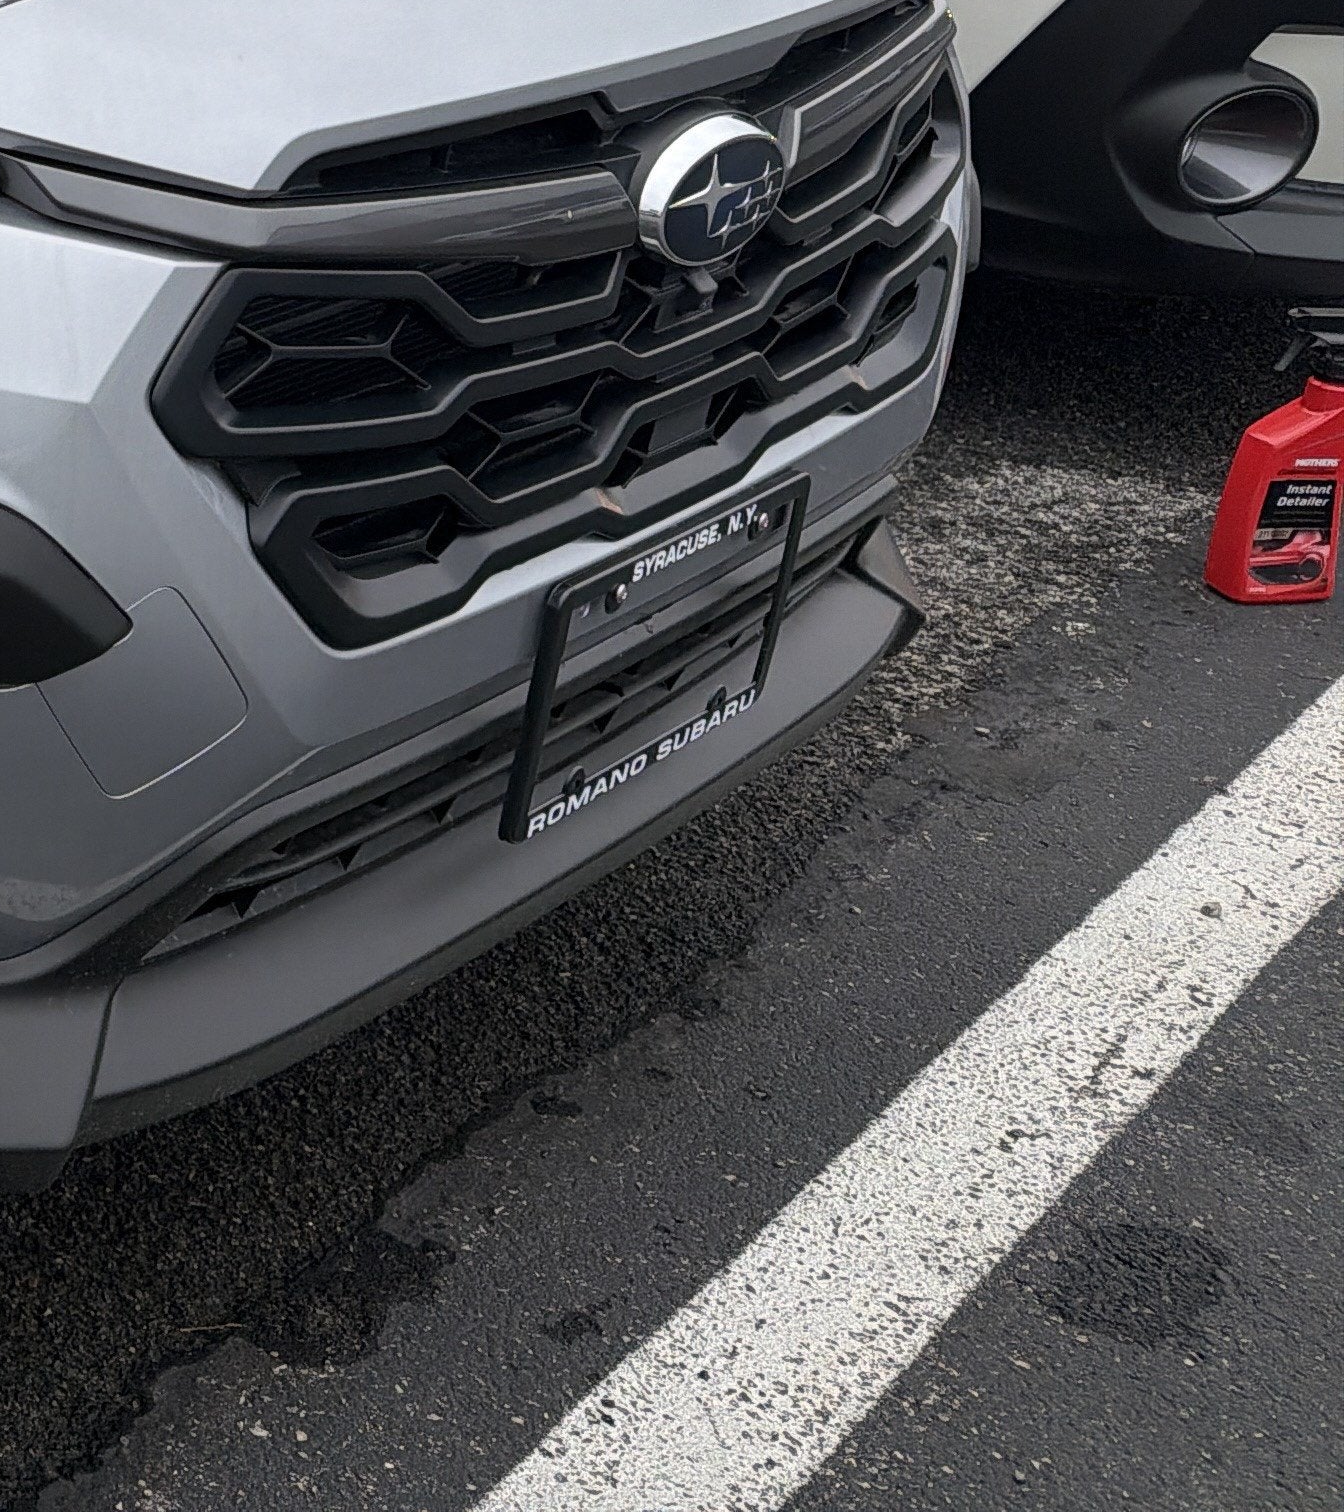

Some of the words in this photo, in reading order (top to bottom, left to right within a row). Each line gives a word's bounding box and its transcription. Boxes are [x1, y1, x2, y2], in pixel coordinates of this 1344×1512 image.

[1276, 496, 1330, 507] Detailer
[1286, 484, 1333, 495] Instant
[631, 524, 723, 583] SYRACUSE,
[726, 504, 759, 536] N.Y.
[527, 752, 649, 839] ROMANO
[656, 690, 757, 762] SUBARU
